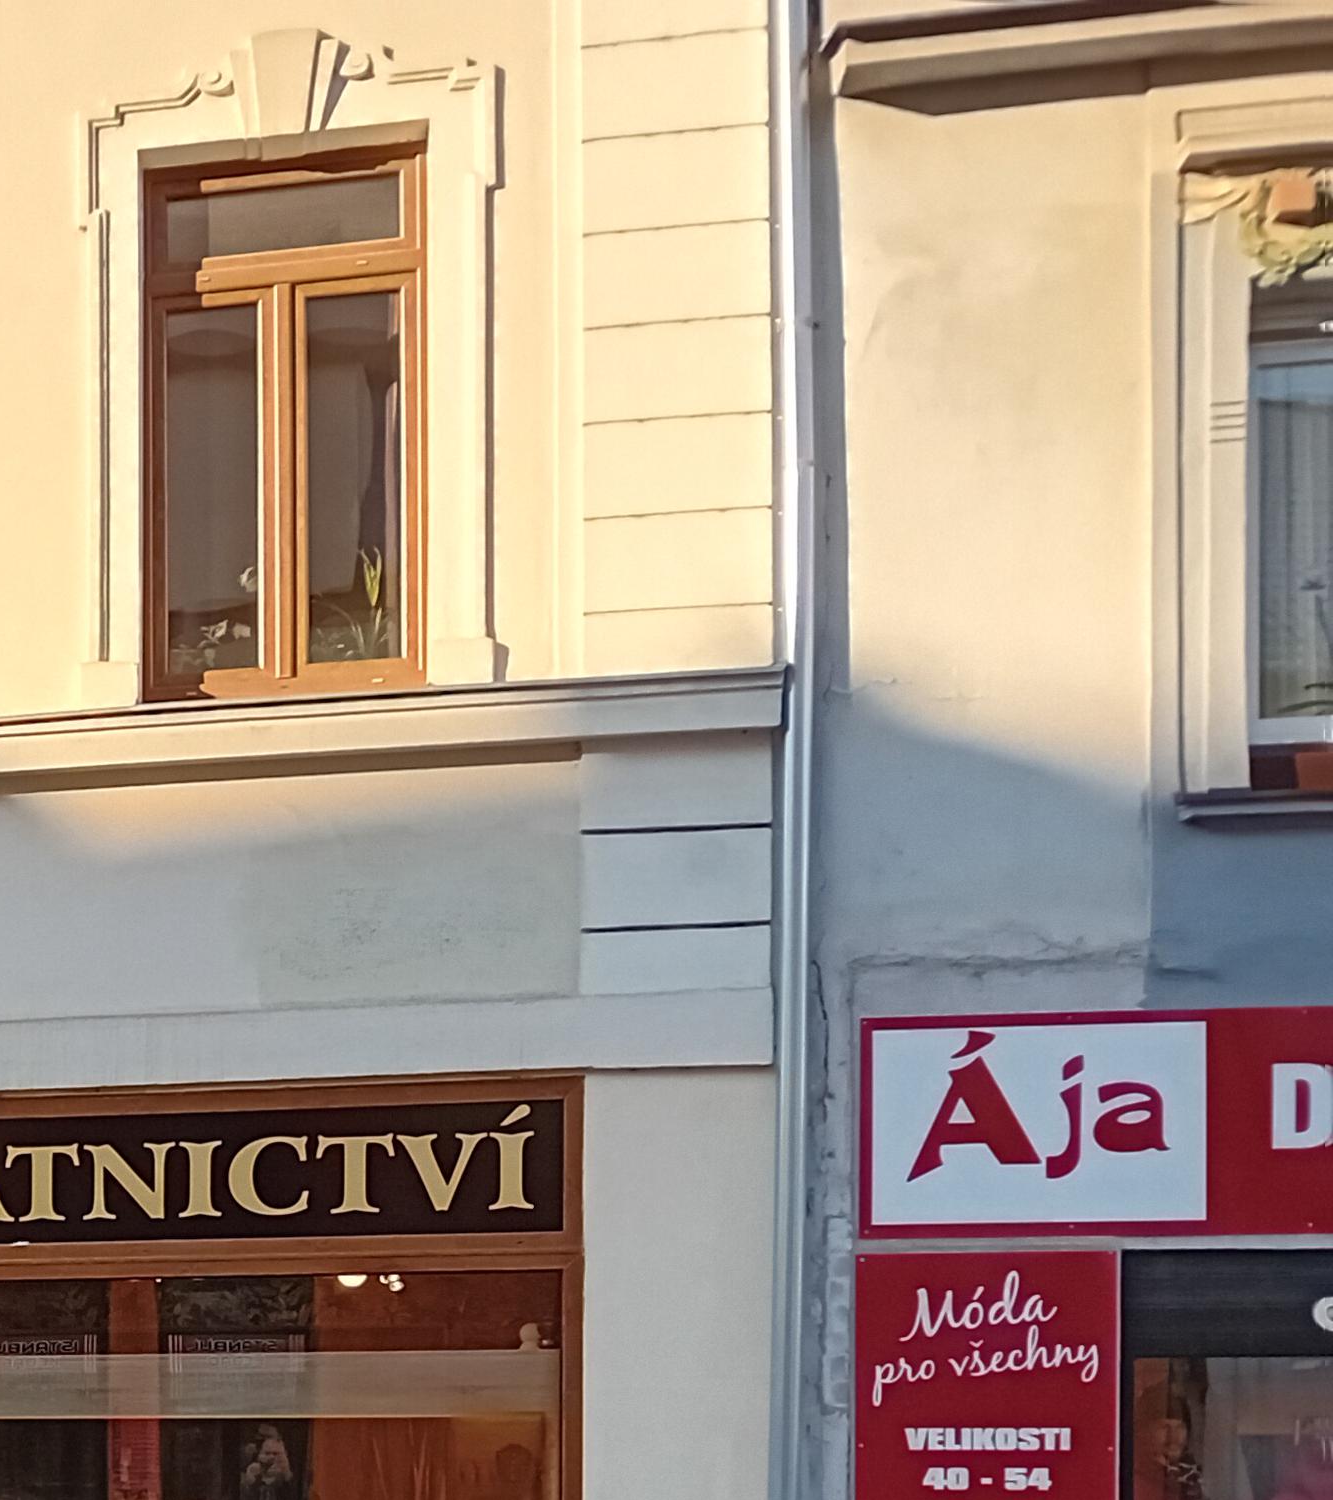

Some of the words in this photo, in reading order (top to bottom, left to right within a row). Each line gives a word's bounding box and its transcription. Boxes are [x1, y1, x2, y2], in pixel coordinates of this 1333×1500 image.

[906, 1029, 1172, 1183] Ája
[899, 1270, 1058, 1342] Móda
[872, 1357, 936, 1407] pro
[948, 1325, 1099, 1383] všechny
[904, 1427, 1071, 1451] VELIKOSTI
[922, 1466, 970, 1491] 40
[1004, 1466, 1053, 1491] 54
